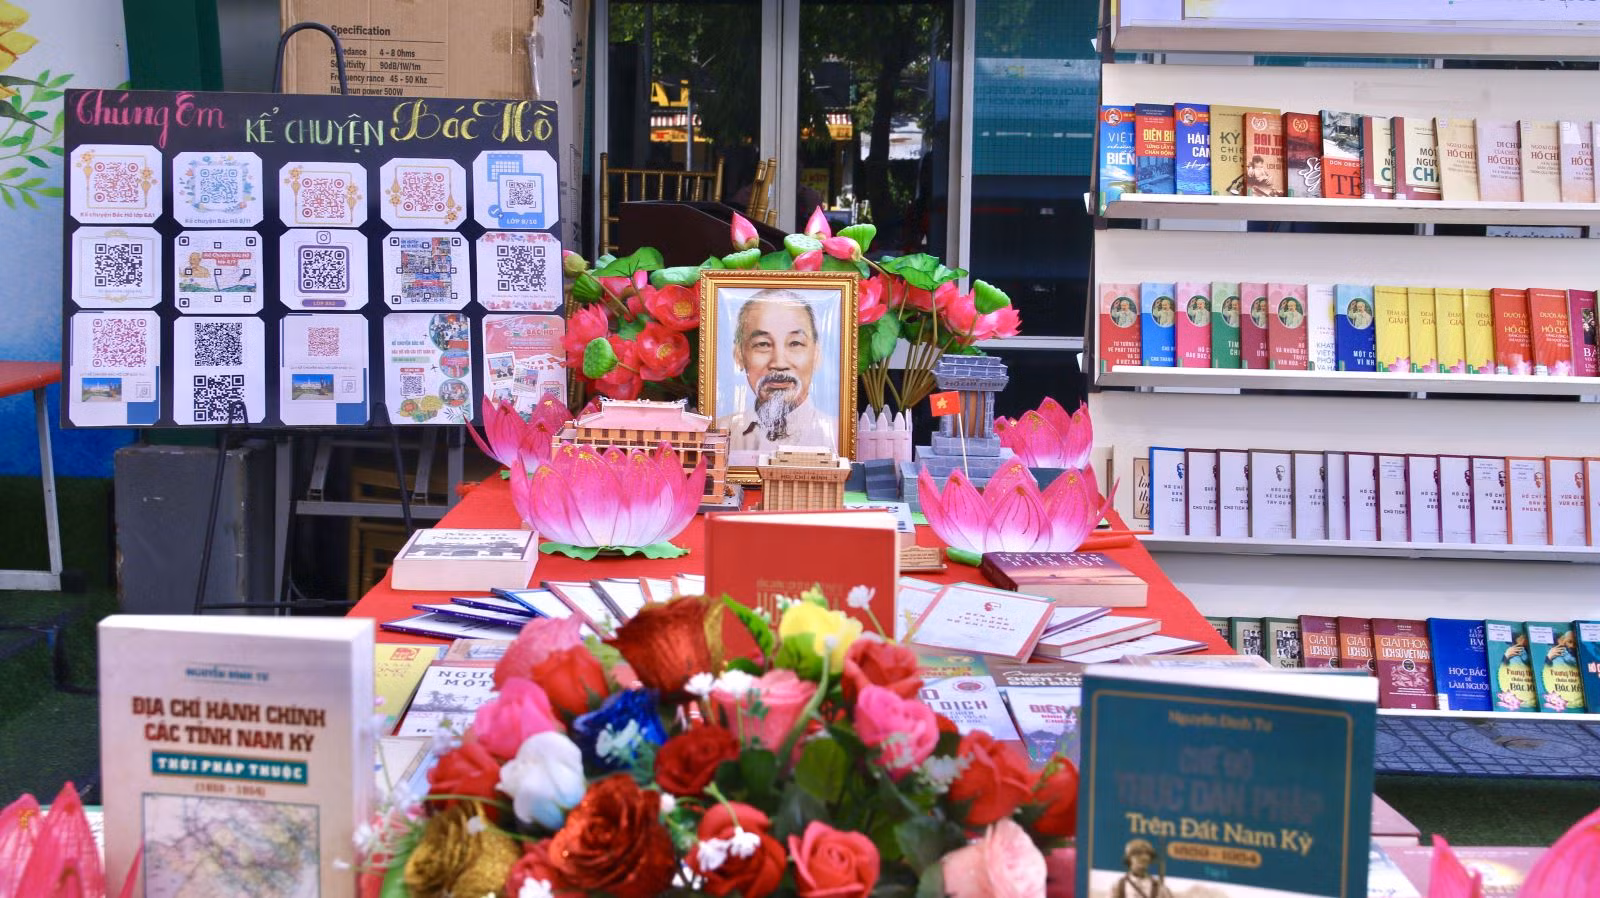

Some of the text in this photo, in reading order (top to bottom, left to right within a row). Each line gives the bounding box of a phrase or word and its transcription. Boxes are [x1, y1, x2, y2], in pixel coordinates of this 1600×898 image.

[331, 25, 391, 36] Specification
[75, 89, 227, 148] Chúng Em
[285, 112, 385, 153] CHUYỆN
[144, 720, 180, 743] CÁC
[236, 731, 284, 750] NAM
[1125, 812, 1177, 837] Trên
[1180, 814, 1218, 842] Đất
[1223, 824, 1277, 850] Nam
